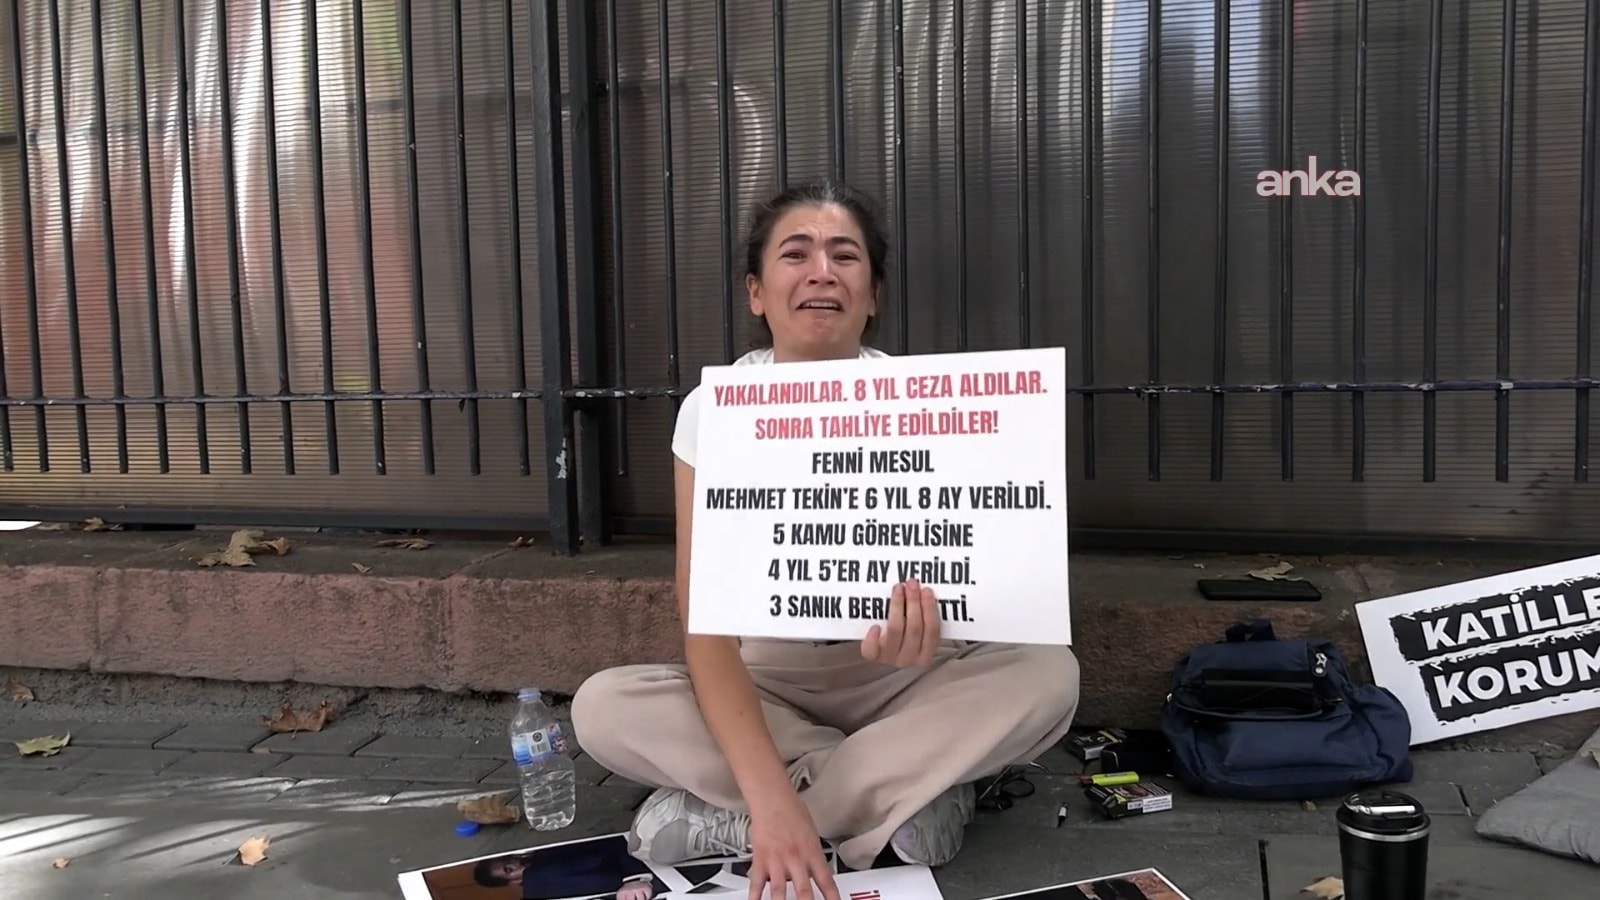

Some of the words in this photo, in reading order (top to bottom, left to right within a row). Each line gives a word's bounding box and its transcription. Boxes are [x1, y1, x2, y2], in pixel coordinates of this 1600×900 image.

[715, 381, 847, 406] YAKALANDILAR.
[855, 380, 866, 401] 8
[873, 378, 899, 400] YIL
[907, 375, 952, 398] CEZA
[960, 371, 1047, 396] ALDILAR.
[756, 418, 813, 439] SONRA
[820, 411, 890, 438] TAHLİYE
[899, 407, 998, 435] EDİLDİLER!
[812, 447, 863, 474] FENNİ
[870, 450, 934, 473] MESUL
[707, 488, 786, 509] MEHMET
[865, 487, 877, 509] 6
[884, 487, 911, 509] YIL
[919, 487, 931, 509] 8
[938, 487, 962, 509] AY
[969, 481, 1051, 509] VERİLDİ.
[773, 523, 784, 545] 5
[792, 524, 845, 545] KAMU
[853, 519, 973, 547] GÖREVLİSİNE
[768, 559, 779, 580] 4
[787, 559, 812, 581] YIL
[867, 560, 890, 582] AY
[897, 556, 976, 586] VERİLDİ.
[770, 595, 781, 616] 3
[788, 595, 842, 619] SANIK
[849, 596, 891, 620] BER
[935, 594, 975, 622] TTİ.
[1421, 587, 1600, 651] KATİLLE
